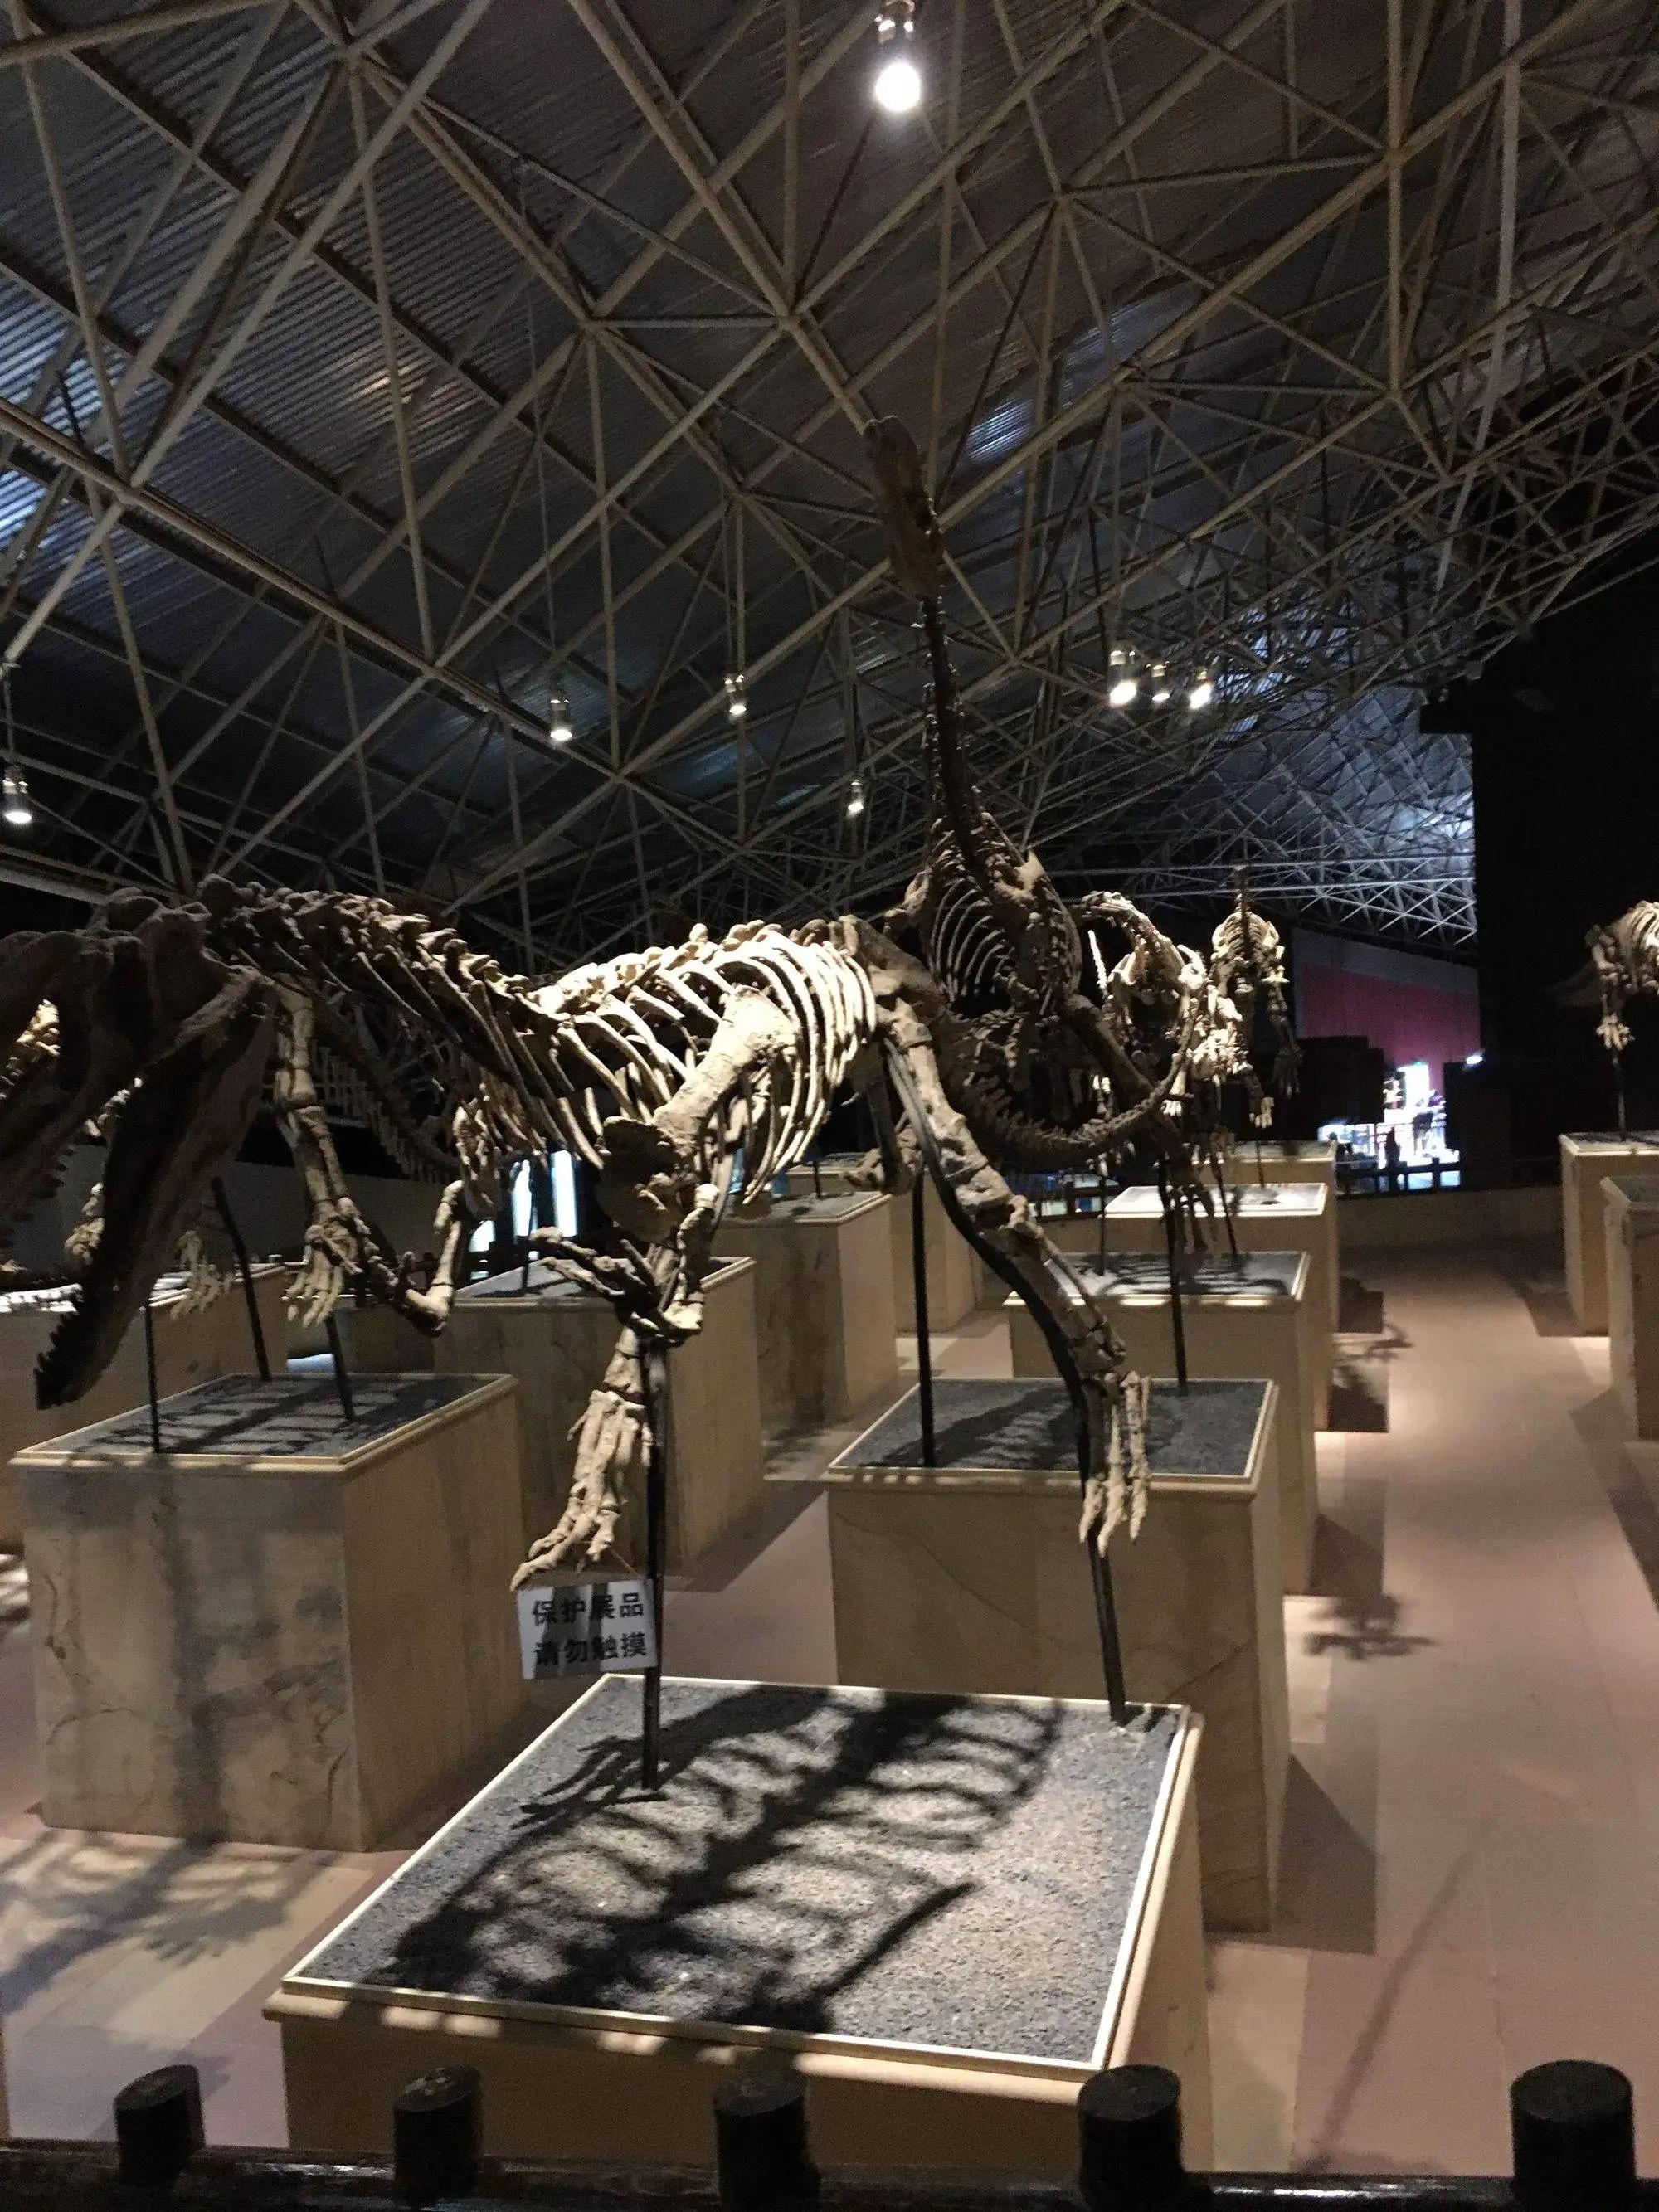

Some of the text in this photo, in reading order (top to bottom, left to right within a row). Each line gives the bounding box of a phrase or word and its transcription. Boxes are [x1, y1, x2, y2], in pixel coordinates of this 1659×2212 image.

[532, 1592, 644, 1626] 保护展品
[536, 1631, 646, 1666] 请勿触摸
